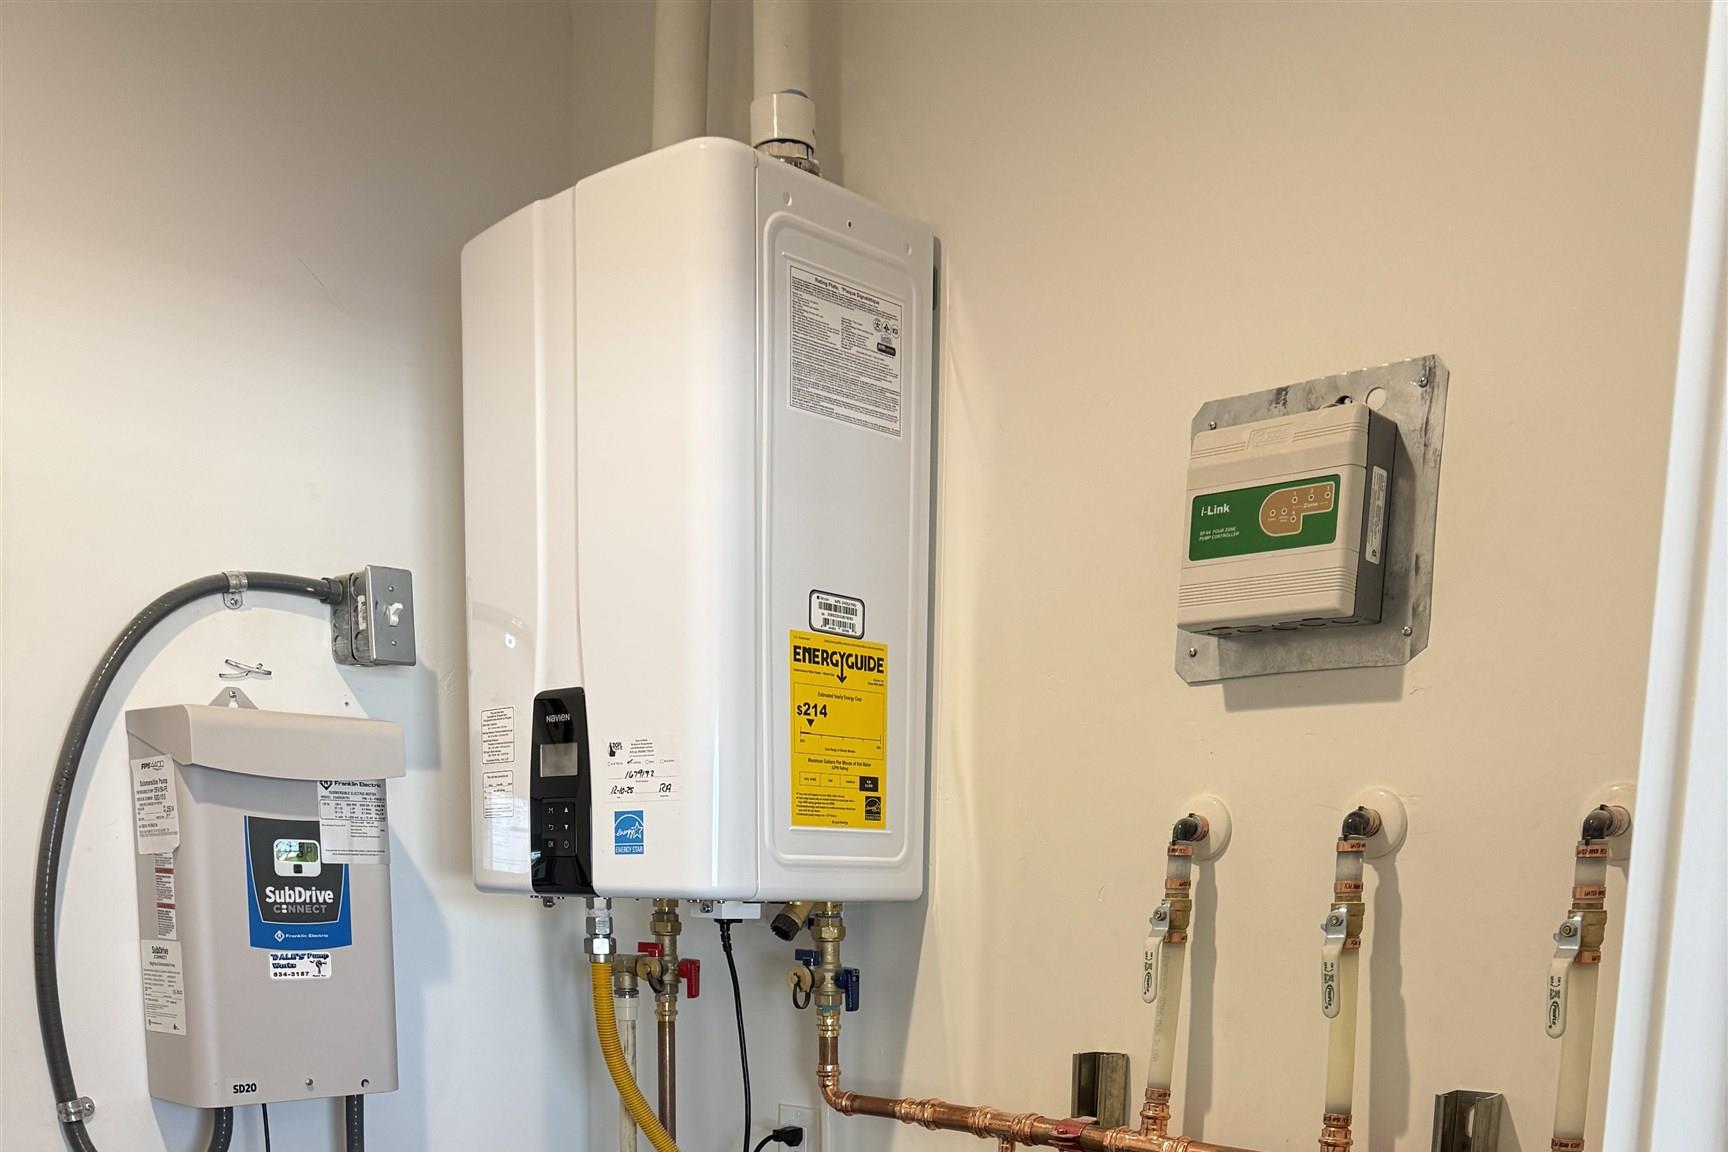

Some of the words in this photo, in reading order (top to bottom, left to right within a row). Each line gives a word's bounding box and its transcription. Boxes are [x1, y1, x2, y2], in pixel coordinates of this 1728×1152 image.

[1200, 503, 1230, 517] i-Link
[793, 644, 885, 674] ENERGYGUIDE
[796, 702, 828, 718] $214
[265, 886, 334, 904] SubDrive
[232, 1082, 257, 1094] SD20
